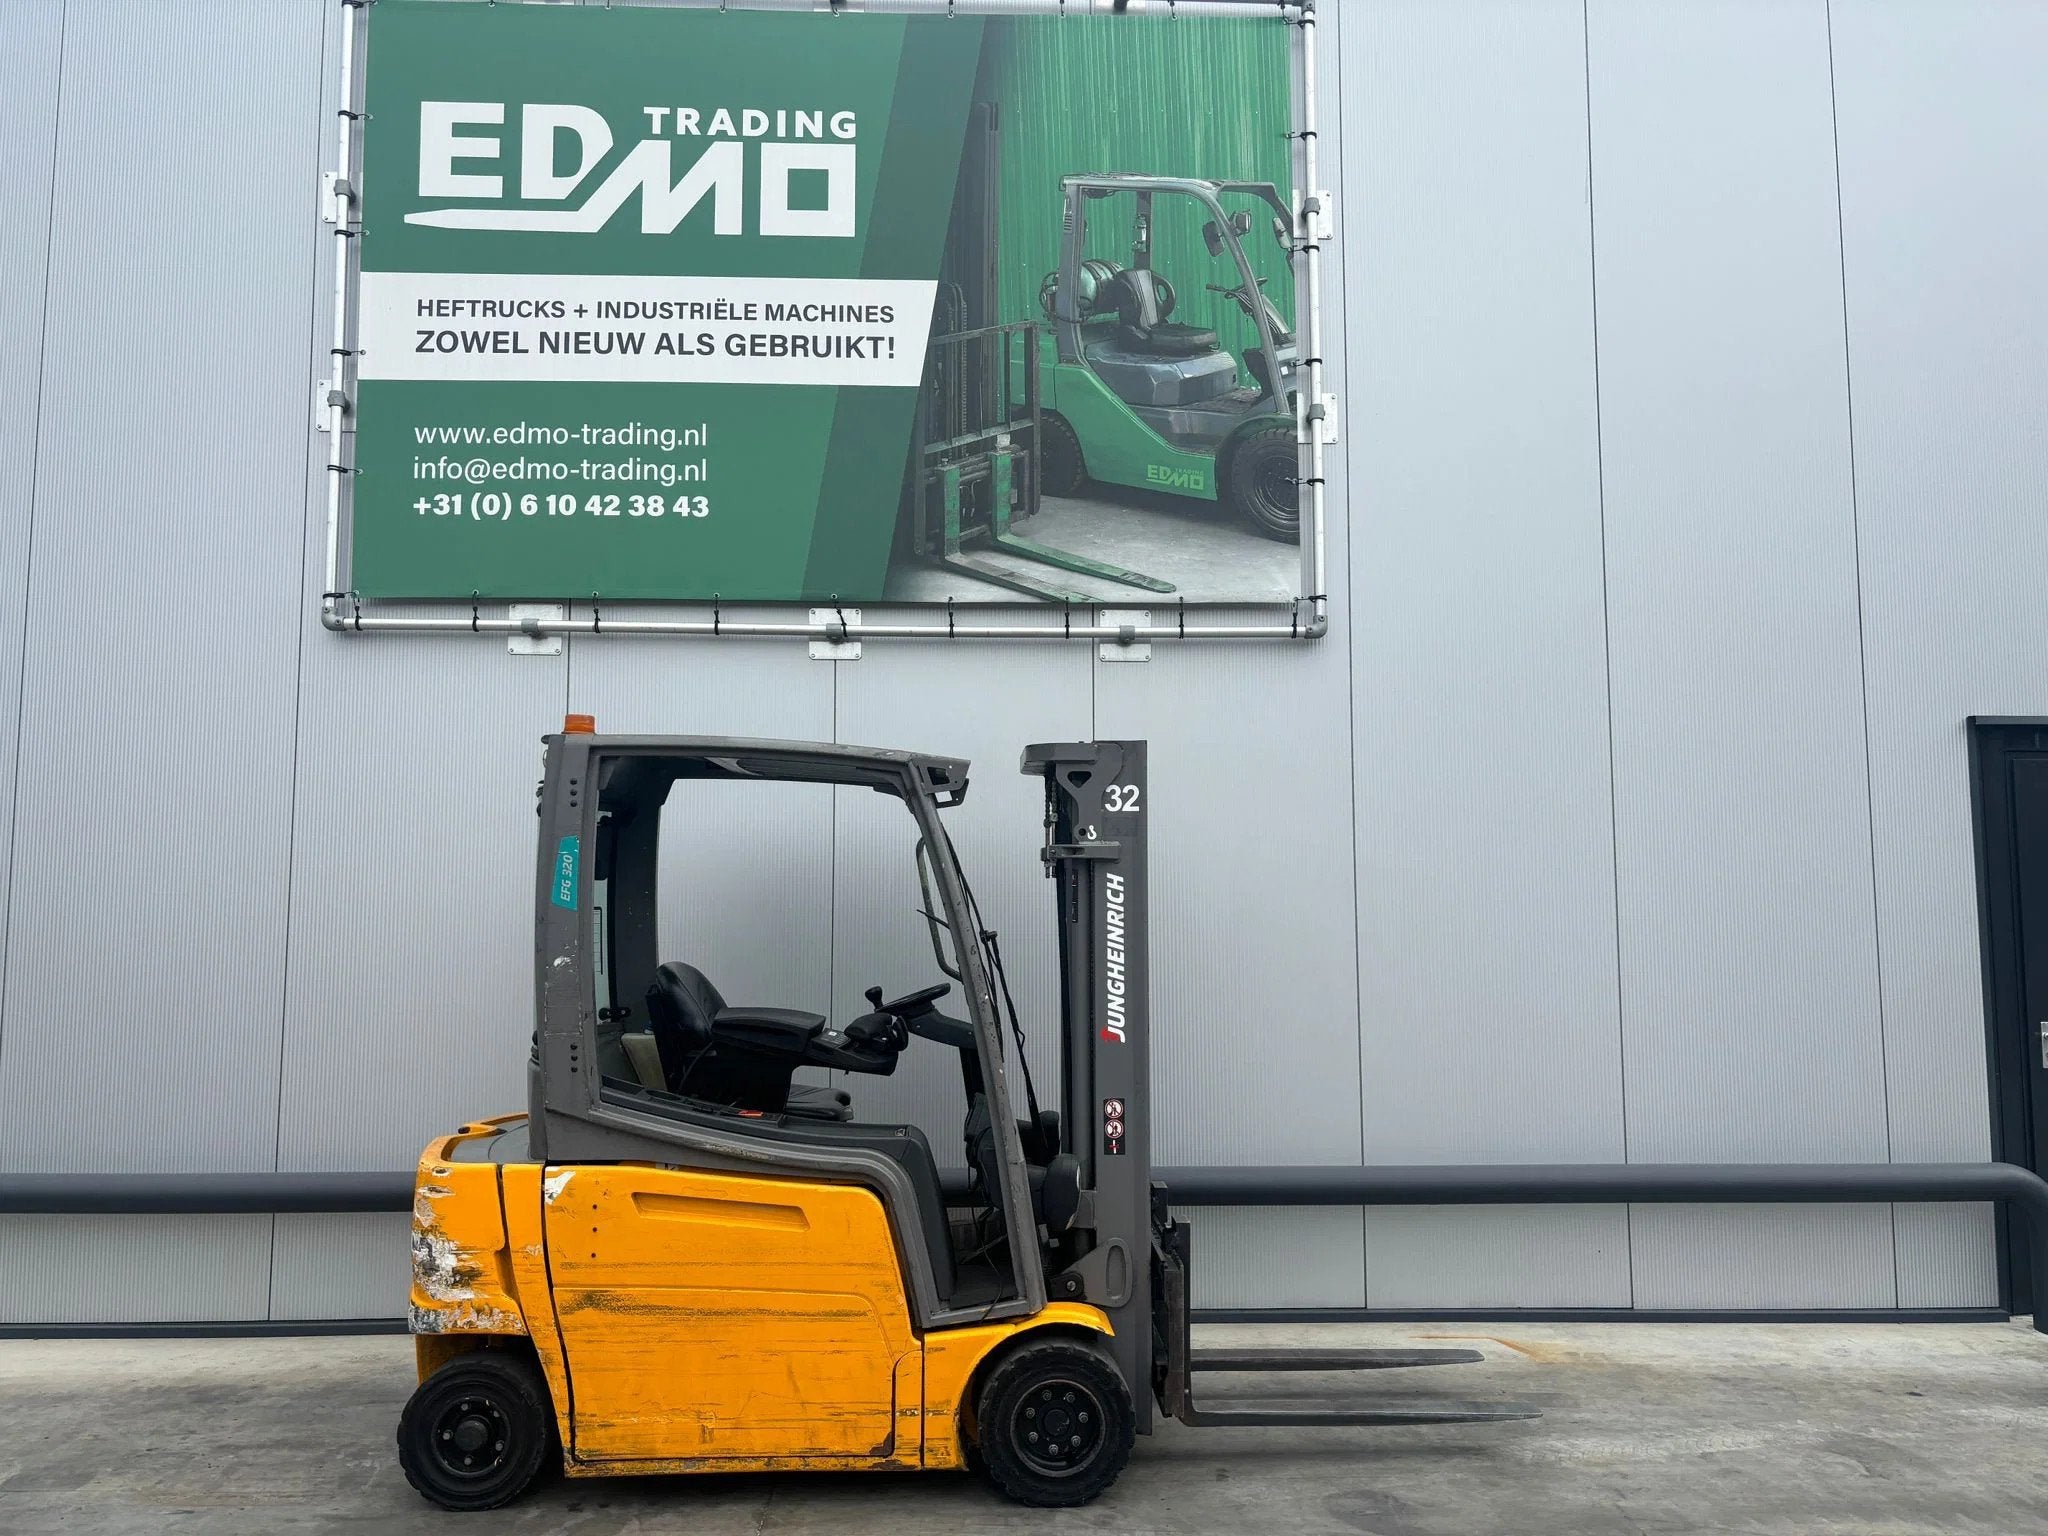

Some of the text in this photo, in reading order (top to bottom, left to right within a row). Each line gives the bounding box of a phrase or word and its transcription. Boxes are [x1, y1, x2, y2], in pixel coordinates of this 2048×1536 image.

[643, 106, 857, 139] TRADING
[404, 100, 857, 238] EDMO
[417, 297, 895, 324] HEFTRUCKS + INDUSTRIËLE MACHINES
[415, 330, 895, 359] ZOWEL NIEUW ALS GEBRUIKT!
[414, 421, 707, 451] www.edmo-trading.nl
[413, 455, 707, 487] info@edmo-trading.nl
[1146, 464, 1204, 490] EDMO
[413, 492, 710, 521] +31 (0) 6 10 42 38 43
[1104, 784, 1140, 812] 32
[560, 854, 574, 902] EFG 320
[1106, 872, 1126, 1044] JUNGHEINRICH
